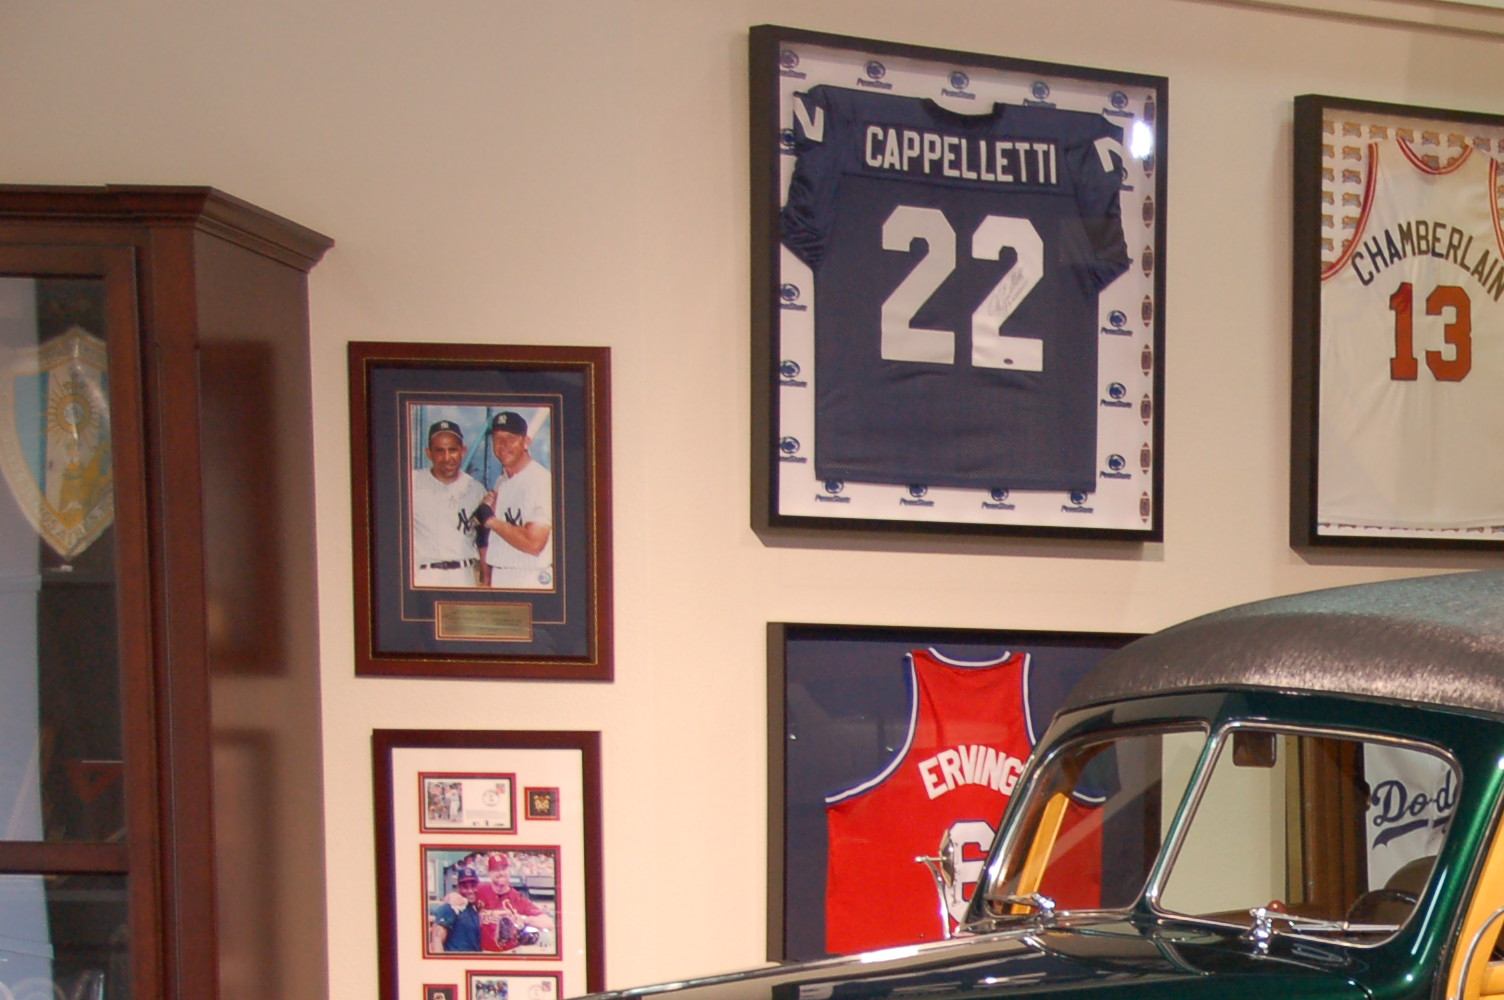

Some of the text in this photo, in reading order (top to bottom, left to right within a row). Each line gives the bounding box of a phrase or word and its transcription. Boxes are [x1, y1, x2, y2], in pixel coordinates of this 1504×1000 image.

[865, 125, 1057, 185] CAPPELLETTI
[881, 205, 1044, 372] 22
[1389, 281, 1472, 382] 13
[918, 744, 1025, 800] ERVING
[1372, 768, 1457, 828] Dod
